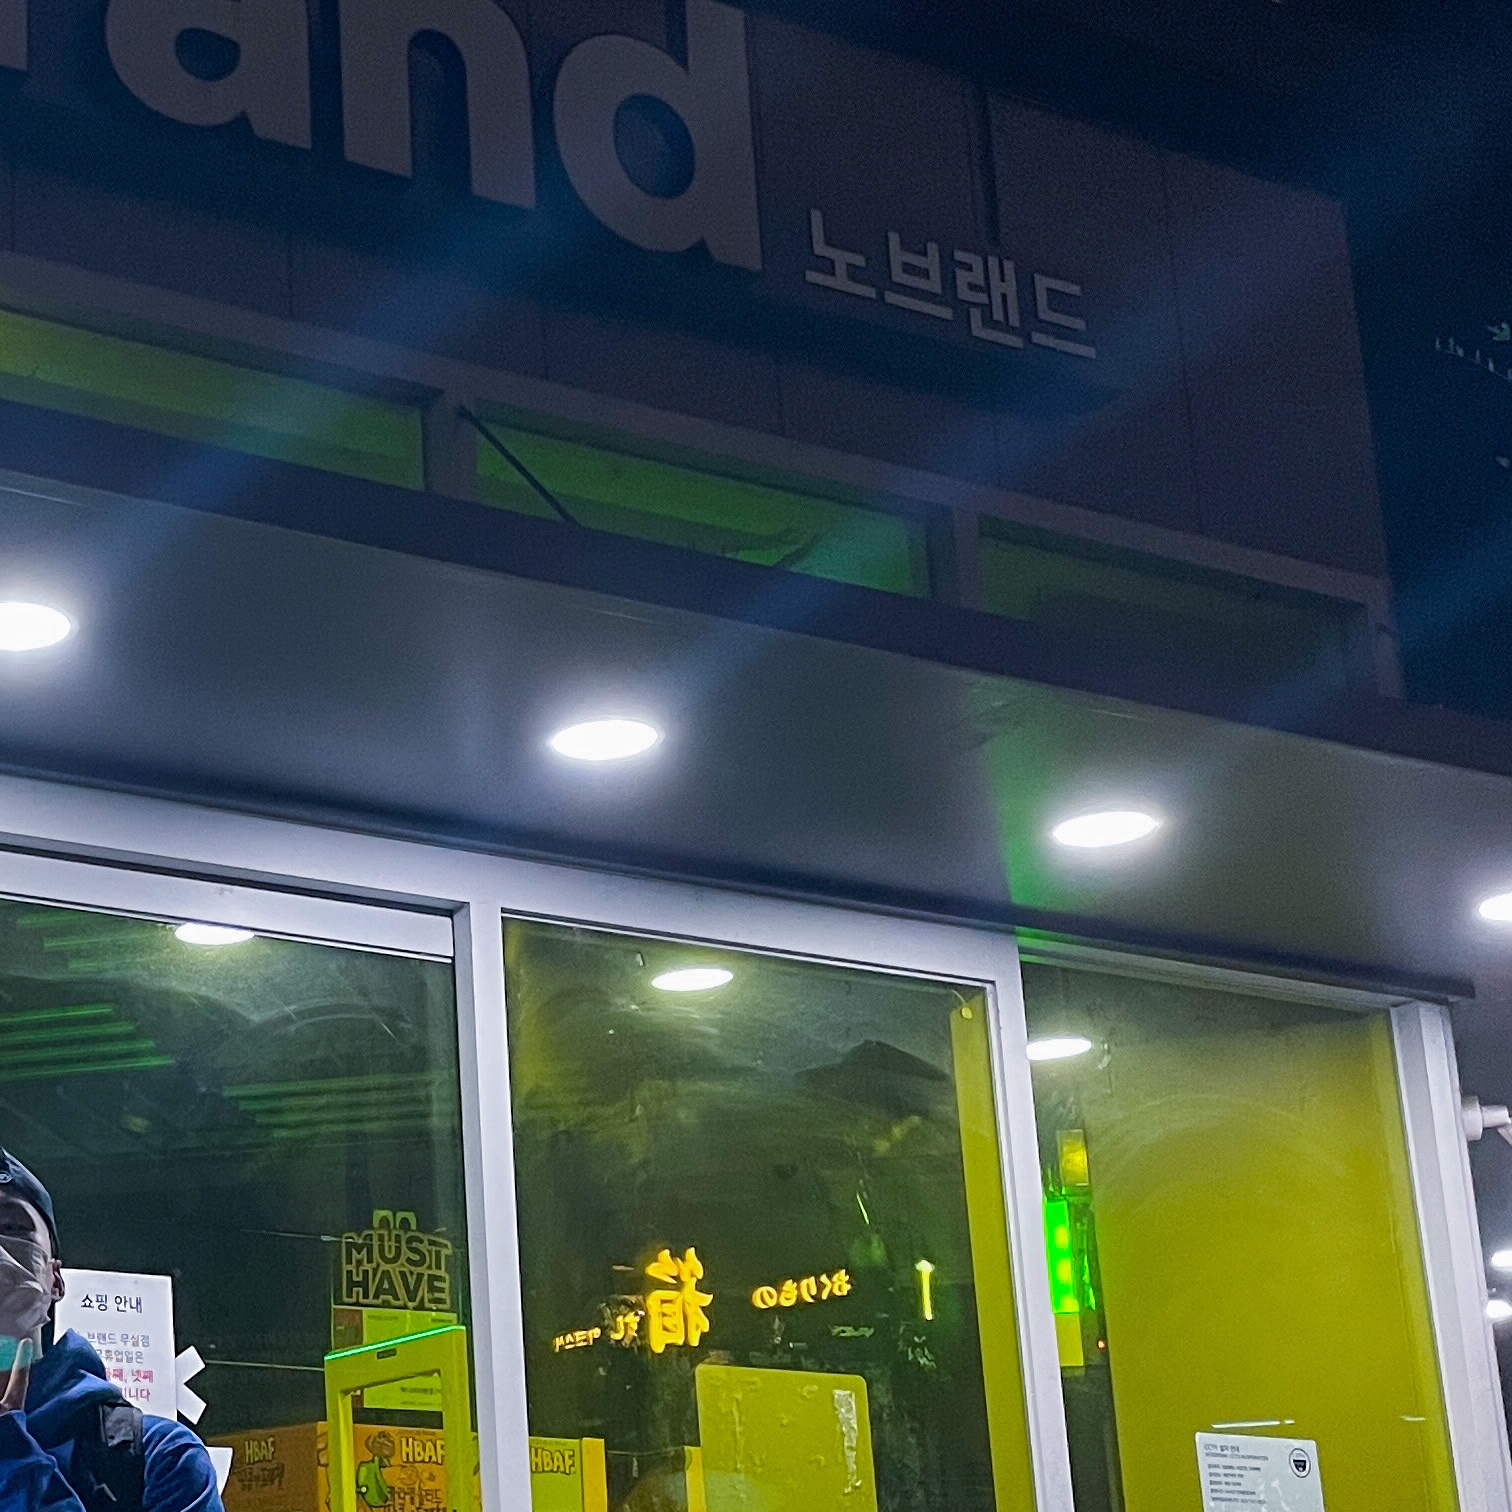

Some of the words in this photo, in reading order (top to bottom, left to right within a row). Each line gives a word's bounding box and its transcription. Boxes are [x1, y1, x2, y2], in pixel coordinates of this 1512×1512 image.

[805, 208, 1097, 359] 노브랜드
[343, 1231, 452, 1271] MUST
[343, 1267, 451, 1309] HAVE
[81, 1294, 108, 1312] 쇼핑
[114, 1295, 143, 1314] 안내
[245, 1436, 275, 1464] HBAF
[400, 1435, 446, 1466] HBAF
[531, 1446, 575, 1474] HBAF
